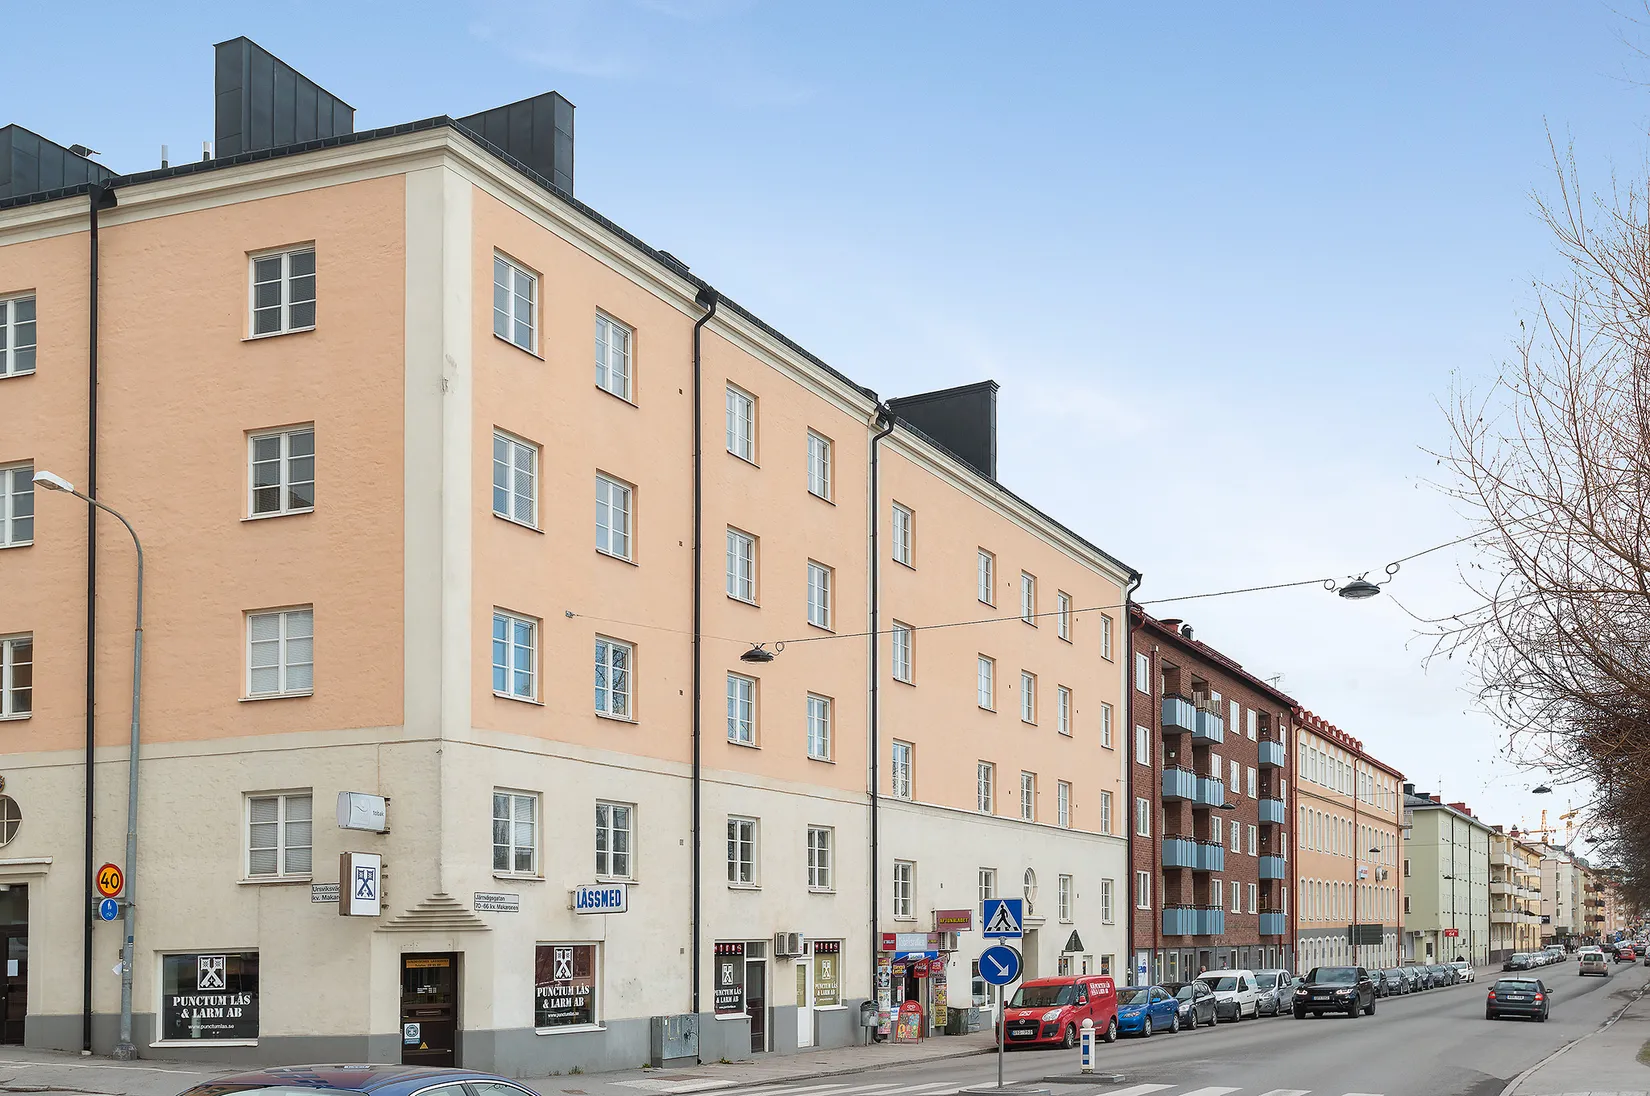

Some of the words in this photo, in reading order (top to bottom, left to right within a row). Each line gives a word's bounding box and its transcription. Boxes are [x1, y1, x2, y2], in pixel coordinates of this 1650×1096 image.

[101, 872, 119, 889] 40
[577, 888, 621, 908] LÅSSMED
[537, 985, 573, 997] PUNCTUM
[576, 983, 590, 995] LÅS
[173, 996, 227, 1006] PUNCTUM
[230, 992, 251, 1005] LÅS
[543, 998, 549, 1008] &
[551, 997, 572, 1008] LARM
[574, 997, 584, 1006] AB
[181, 1008, 189, 1018] &
[192, 1007, 223, 1018] LARM
[227, 1007, 242, 1017] AB
